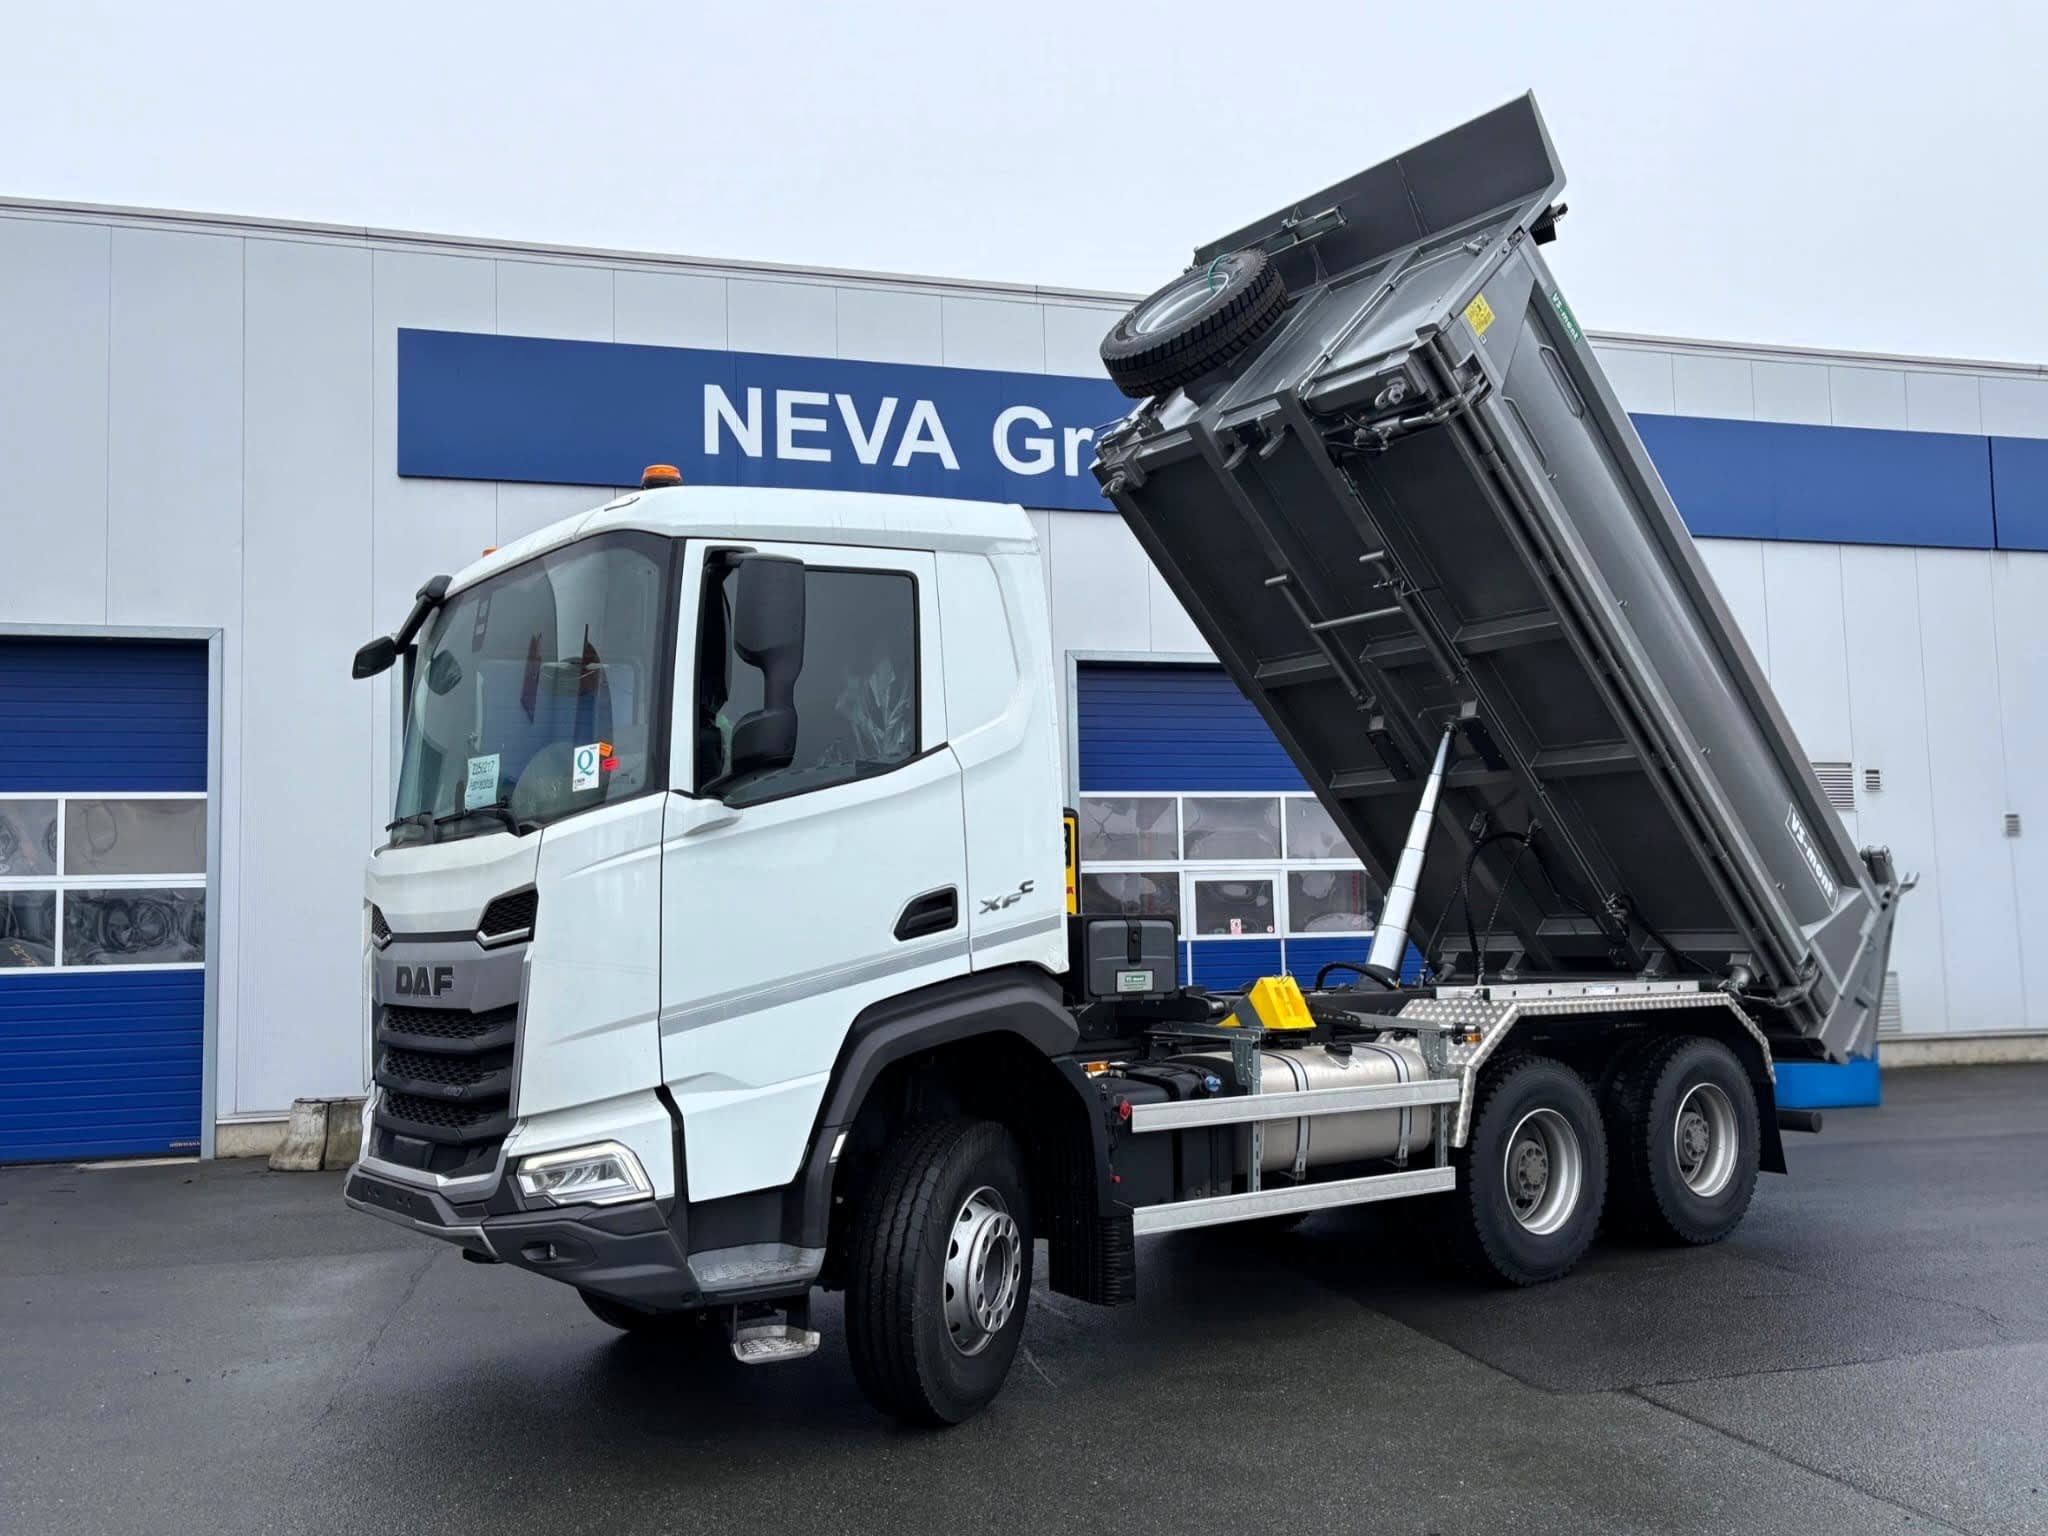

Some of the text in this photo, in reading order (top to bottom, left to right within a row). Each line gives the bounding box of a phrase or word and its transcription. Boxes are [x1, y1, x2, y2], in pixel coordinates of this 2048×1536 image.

[703, 383, 1096, 478] NEVA Gr
[577, 749, 595, 776] Q
[395, 965, 454, 996] DAF
